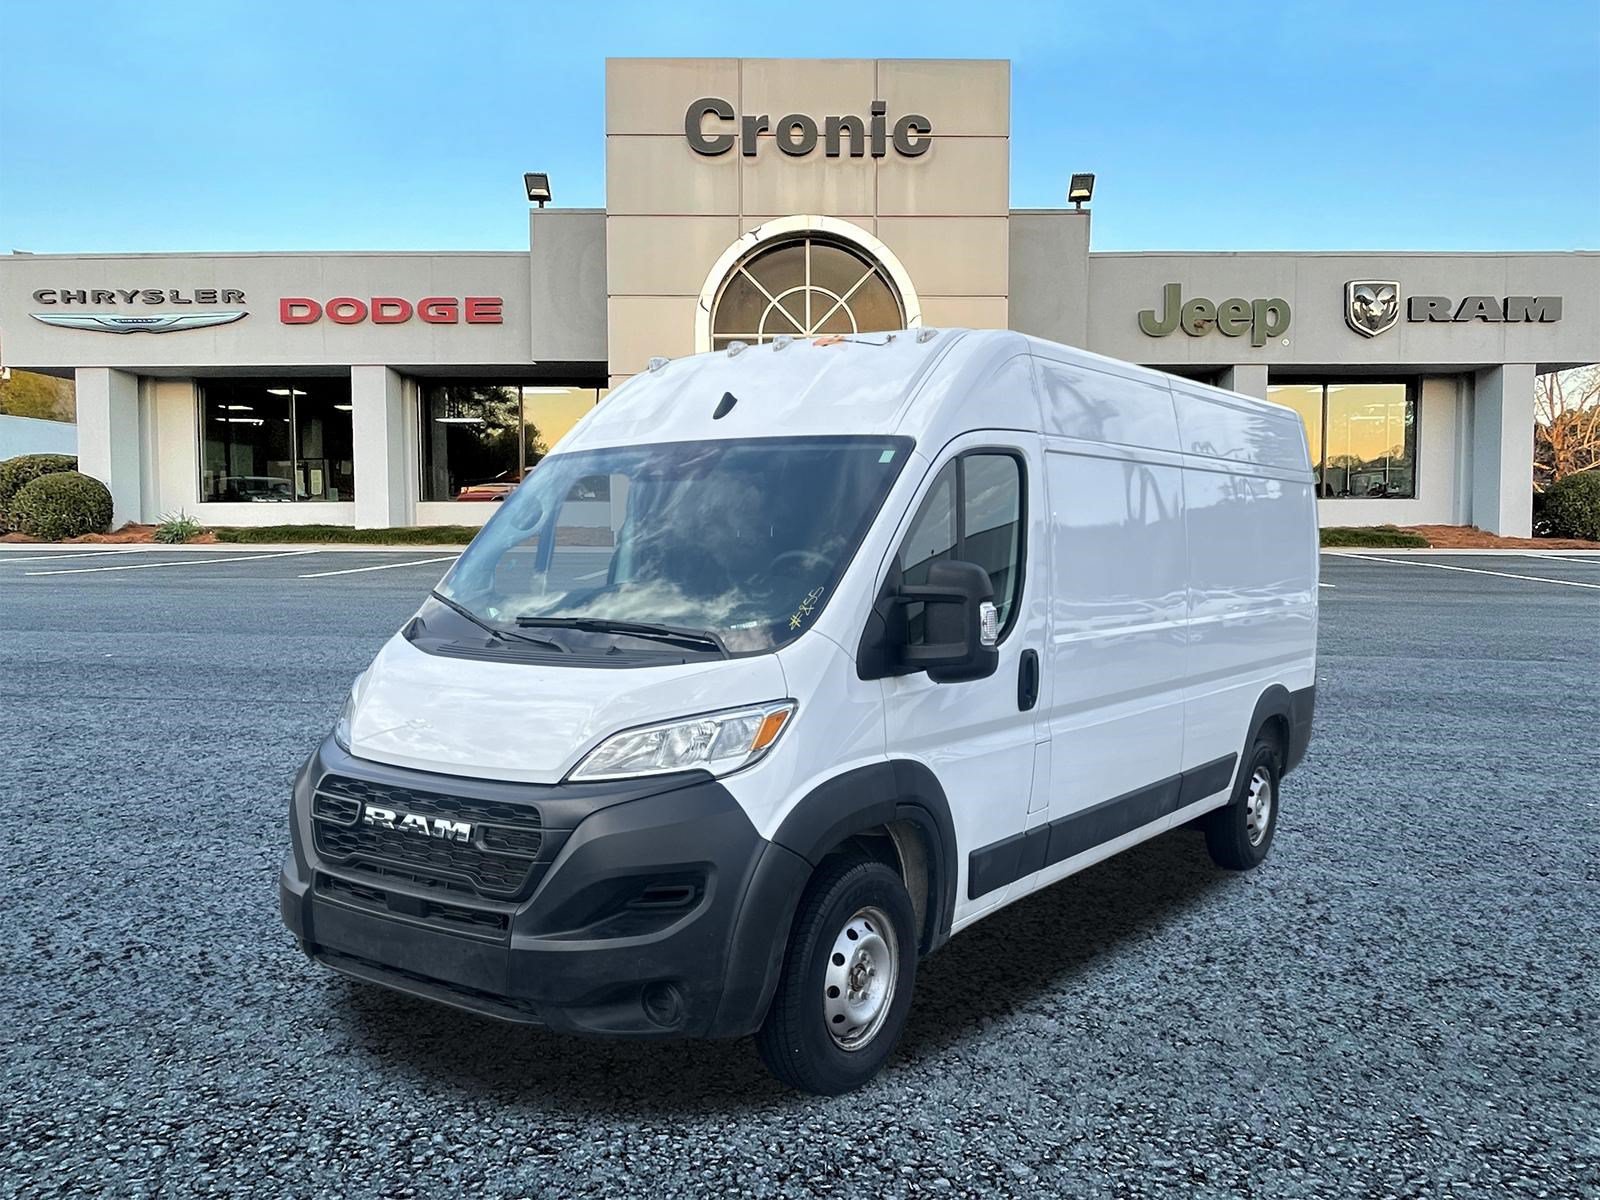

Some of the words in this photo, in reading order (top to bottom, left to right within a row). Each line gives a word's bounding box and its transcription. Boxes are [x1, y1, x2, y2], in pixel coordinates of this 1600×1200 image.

[685, 97, 932, 158] Cronic
[32, 289, 247, 304] CHRYSLER
[279, 297, 504, 325] DODGE
[1407, 296, 1563, 322] RAM
[1138, 283, 1291, 347] Jeep
[364, 806, 472, 843] RAM
